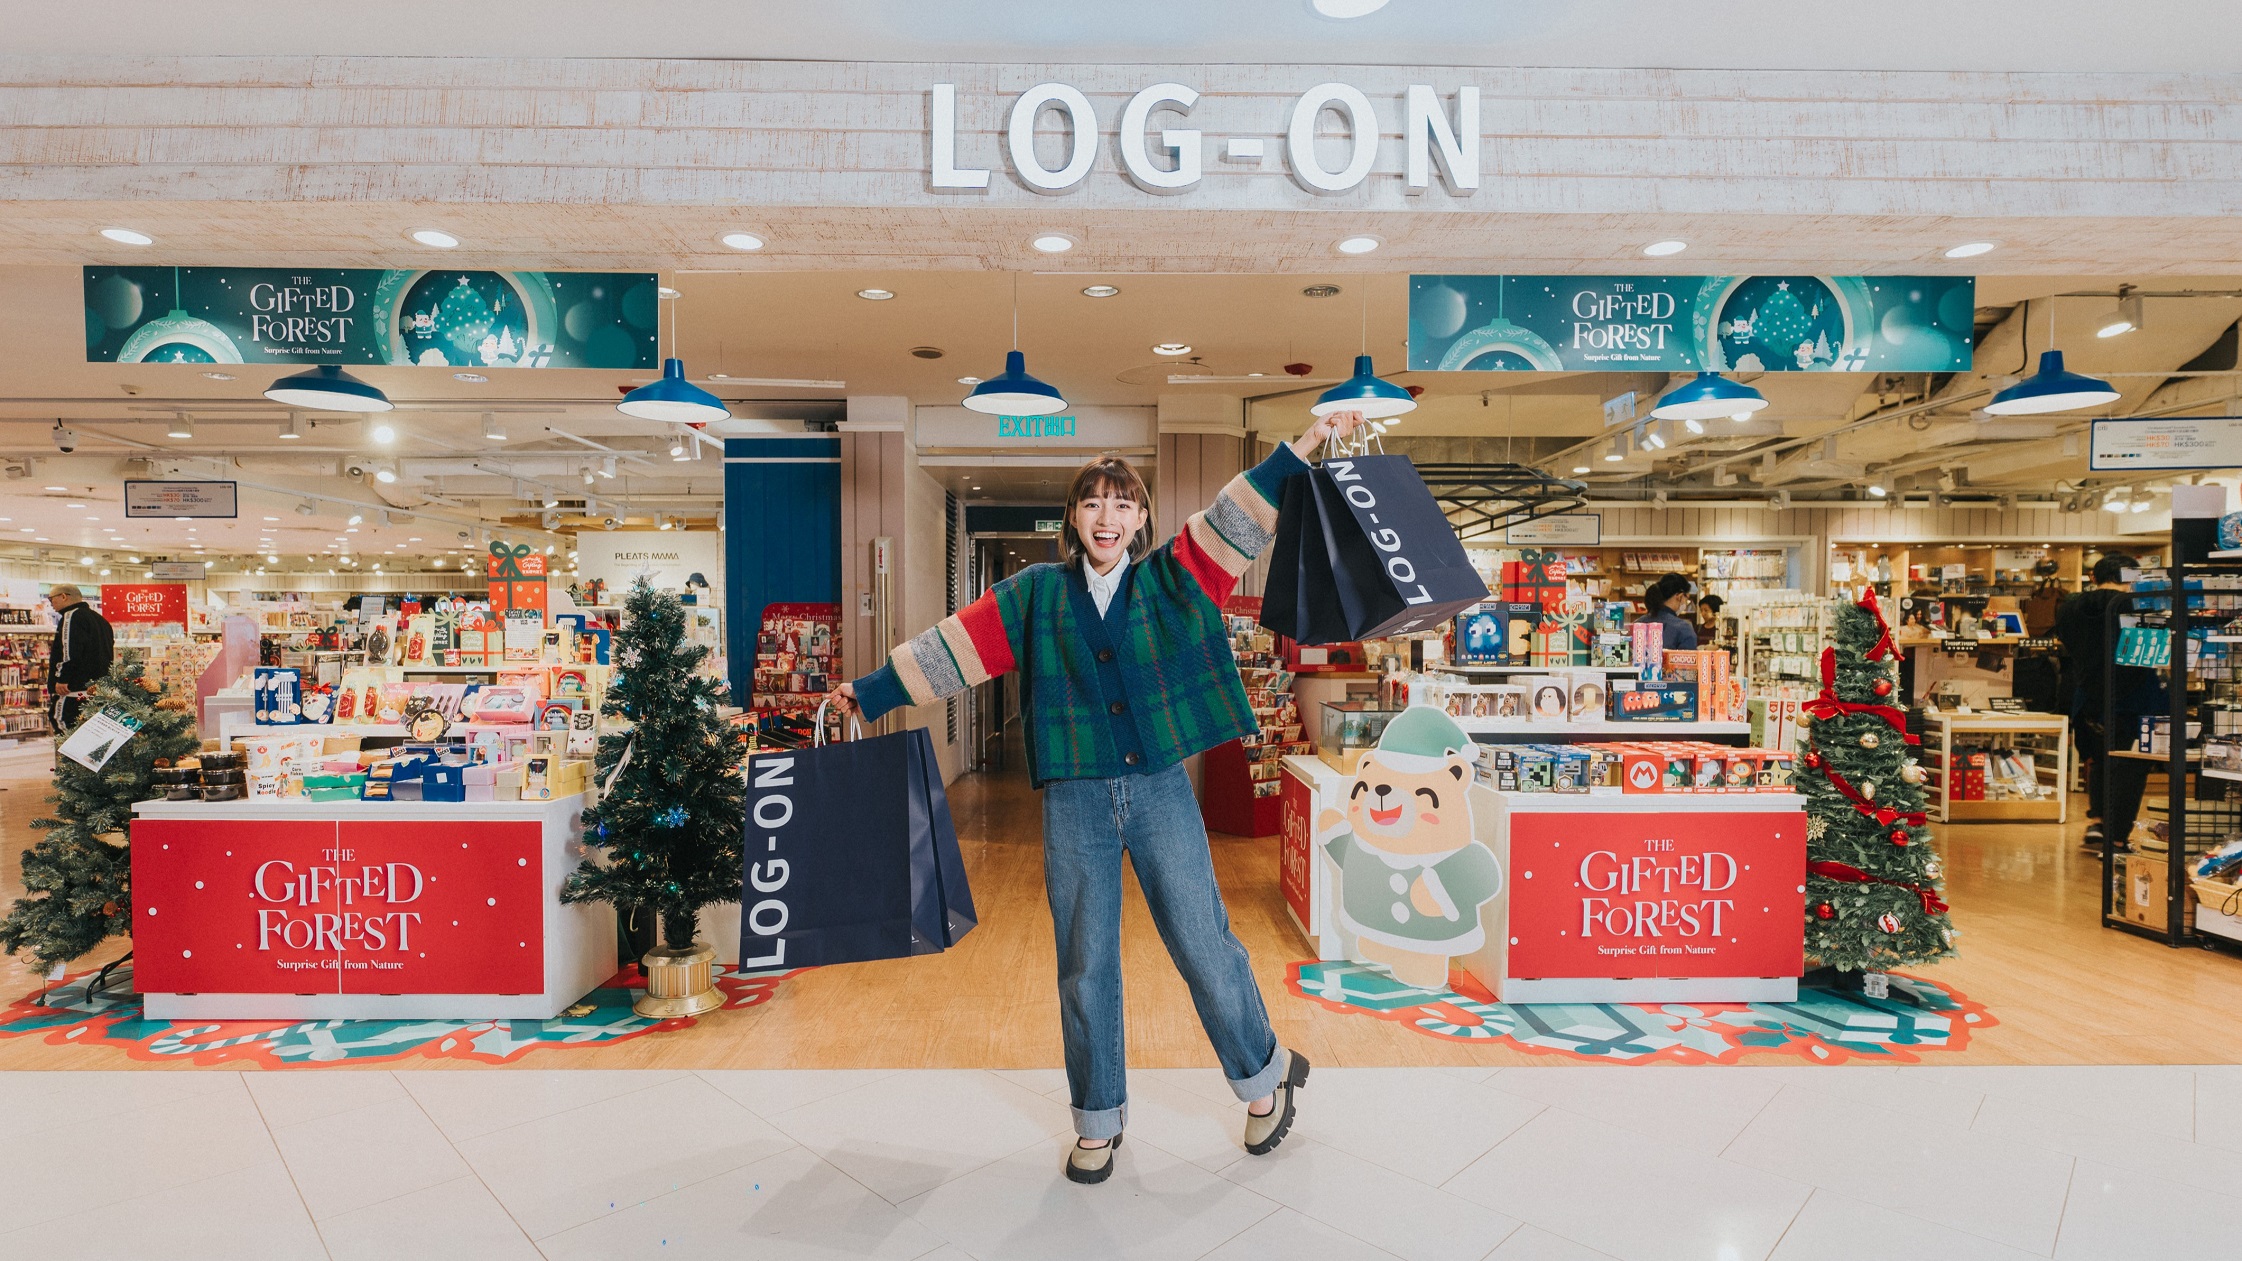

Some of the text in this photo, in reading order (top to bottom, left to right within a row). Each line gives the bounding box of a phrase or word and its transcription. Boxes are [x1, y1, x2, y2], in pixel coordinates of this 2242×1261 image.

[932, 82, 1480, 194] LOG-ON
[292, 276, 312, 285] THE
[1614, 283, 1634, 292] THE
[250, 283, 354, 313] GIFTED
[1572, 291, 1675, 320] GIFTED
[252, 315, 354, 342] FOREST
[1573, 322, 1673, 349] FOREST
[264, 347, 342, 356] Surprise Gift from Nature
[1583, 354, 1609, 362] Surprise
[998, 415, 1076, 437] EXIT 出口
[1328, 461, 1433, 605] LOG-ON
[615, 552, 680, 560] PLEATS MAMA
[126, 592, 163, 603] GIFTED
[127, 602, 163, 613] FOREST
[800, 612, 842, 620] Christmas
[1669, 654, 1697, 664] MONOPOLY
[1644, 839, 1674, 851] THE
[322, 848, 355, 861] THE
[746, 757, 795, 968] LOG-ON
[1580, 851, 1737, 894] GIFTED
[255, 860, 423, 906] GIFTED
[1581, 898, 1734, 938] FOREST
[258, 909, 421, 951] FOREST
[1598, 945, 1716, 957] Surprise Gift from Nature
[277, 959, 404, 971] Surprise Gift from Nature
